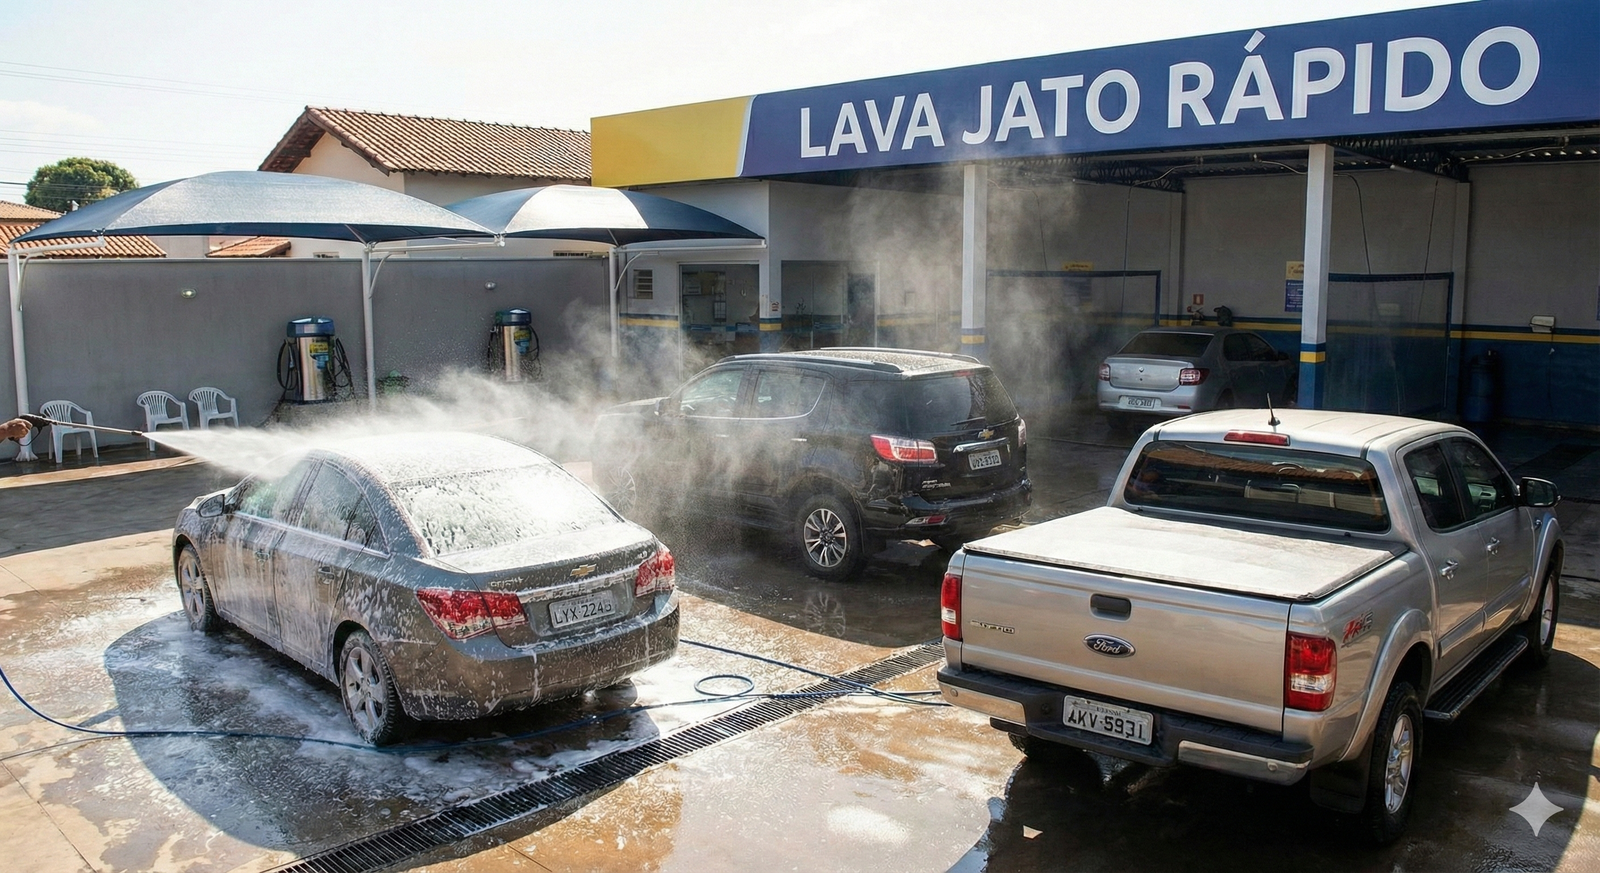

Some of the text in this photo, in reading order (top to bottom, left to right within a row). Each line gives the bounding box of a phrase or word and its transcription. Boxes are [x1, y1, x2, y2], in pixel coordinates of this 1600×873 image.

[800, 26, 1540, 158] LAVA JATO RÁPIDO
[1093, 638, 1123, 654] Ford
